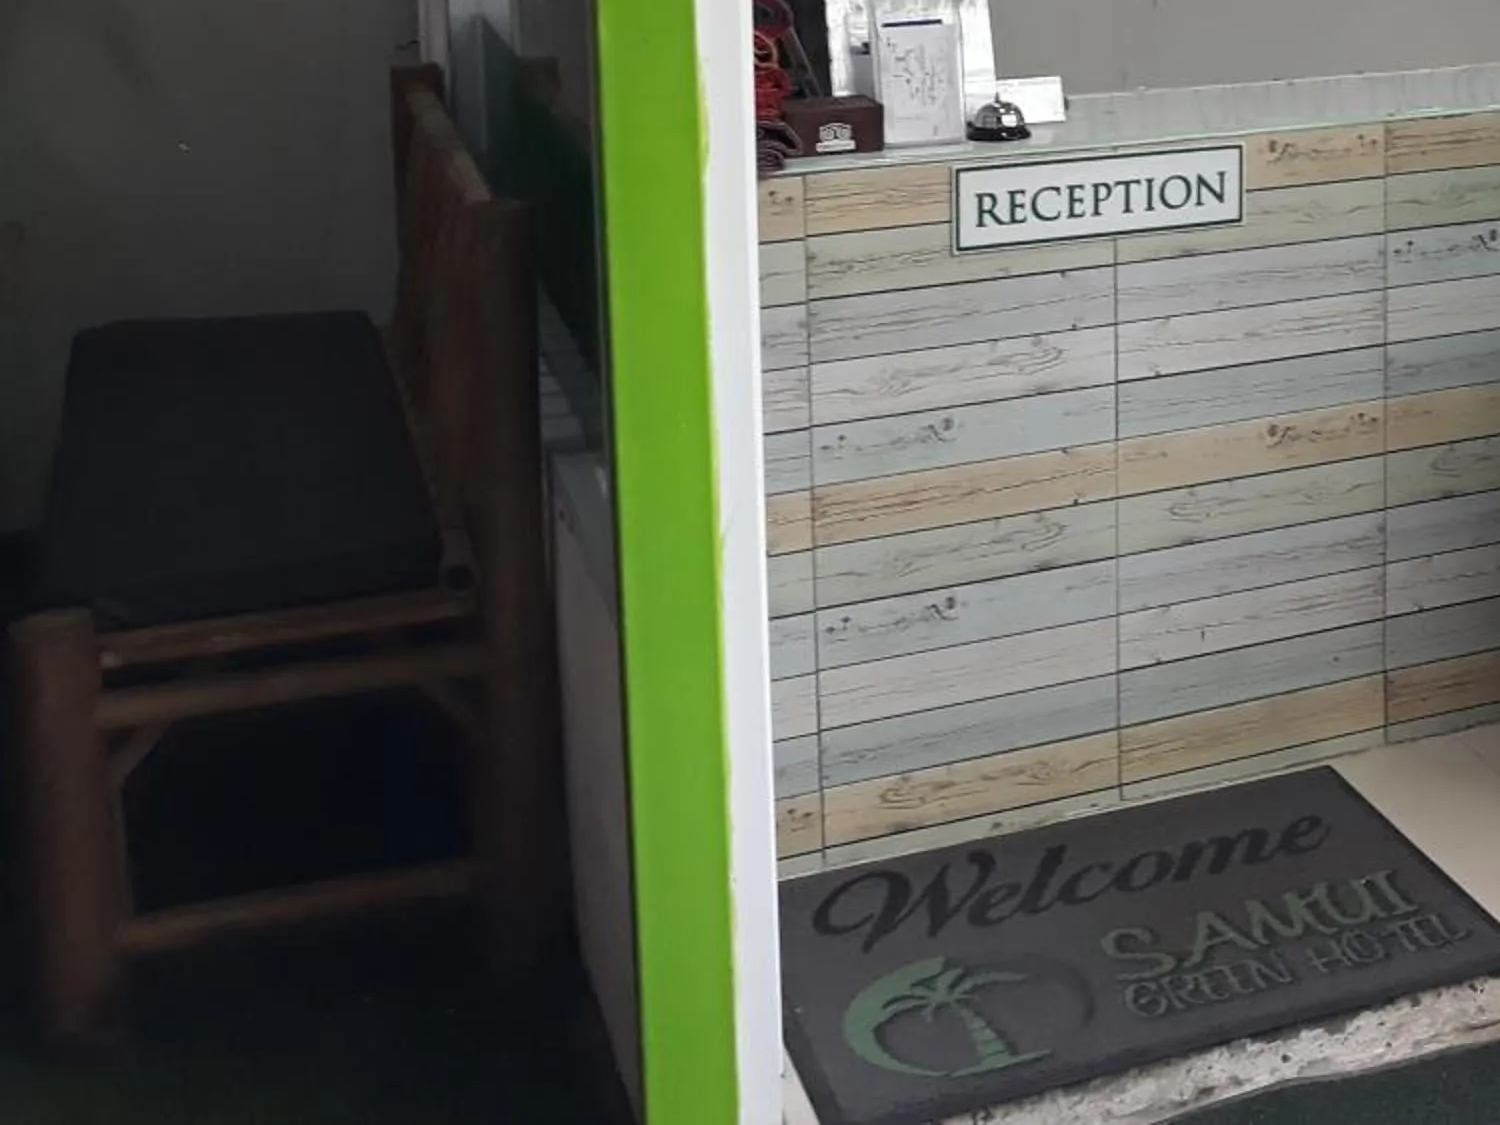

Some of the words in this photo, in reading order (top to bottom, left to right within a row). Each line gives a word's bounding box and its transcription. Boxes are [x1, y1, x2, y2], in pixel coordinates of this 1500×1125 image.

[974, 170, 1228, 229] RECEPTION
[811, 812, 1334, 955] Welcome
[1100, 870, 1420, 984] SAMUI
[1124, 945, 1297, 1018] GREEN
[1310, 912, 1471, 978] HOTEL
